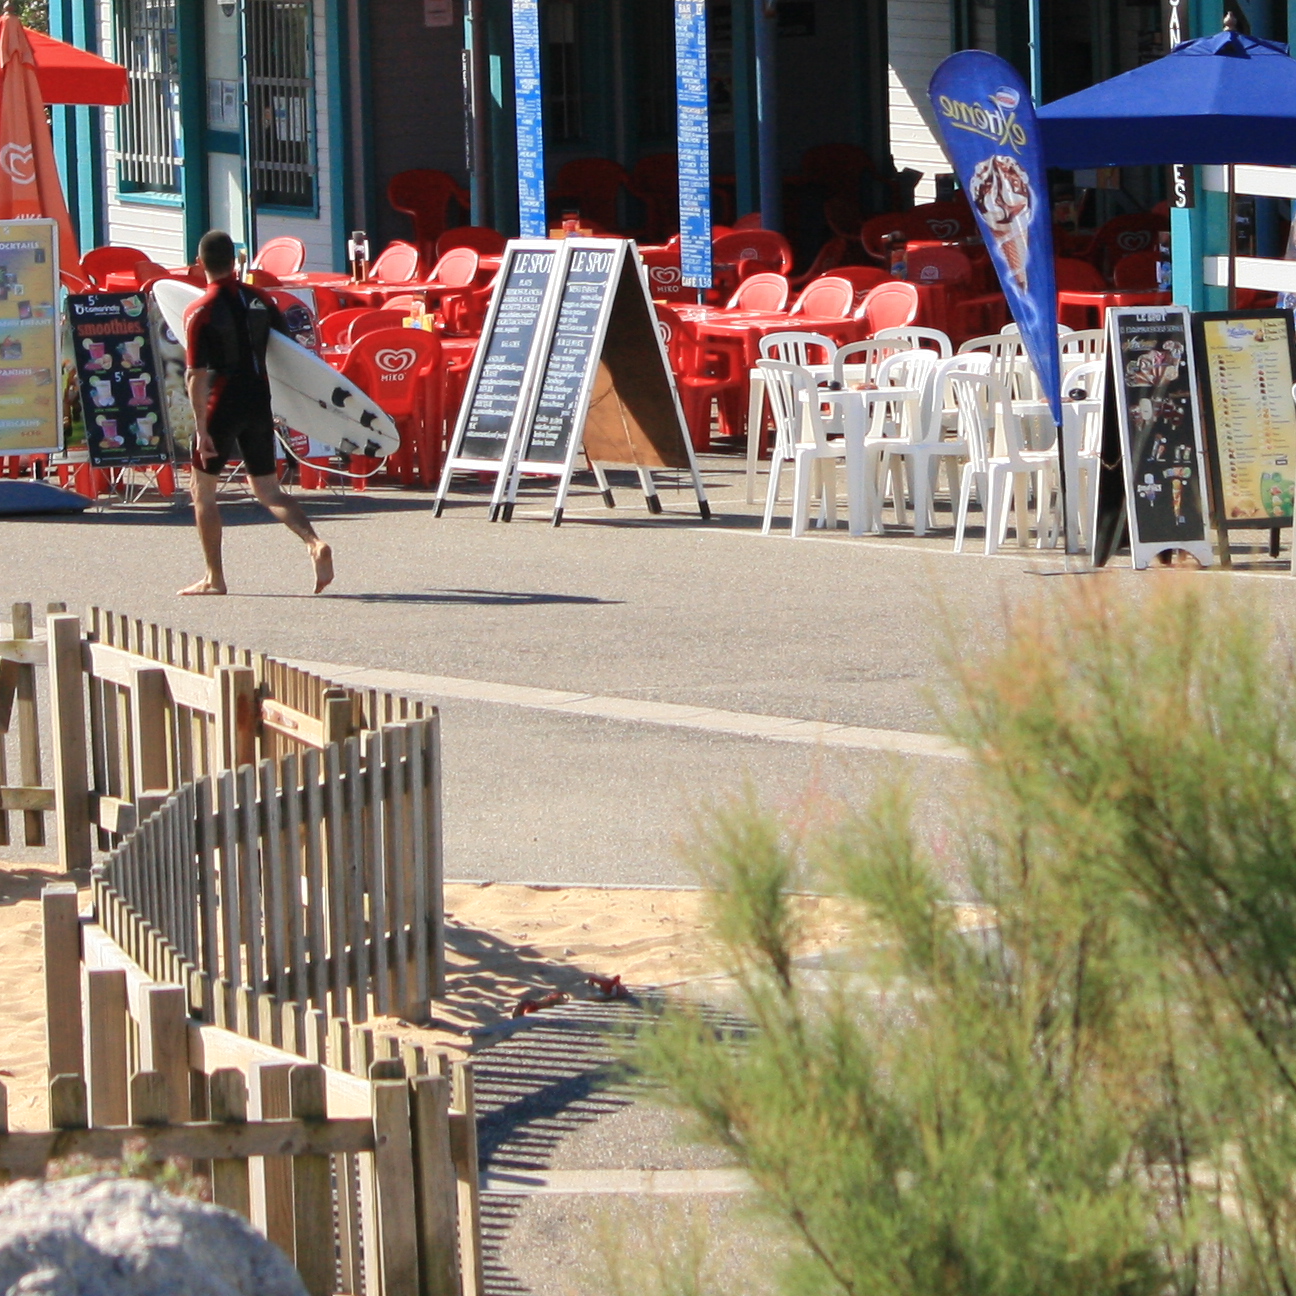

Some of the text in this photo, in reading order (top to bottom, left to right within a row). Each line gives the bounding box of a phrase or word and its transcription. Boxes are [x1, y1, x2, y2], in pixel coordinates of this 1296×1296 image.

[513, 253, 556, 274] LE SPOT
[570, 251, 615, 274] LE SPOT
[380, 373, 405, 382] MIKO
